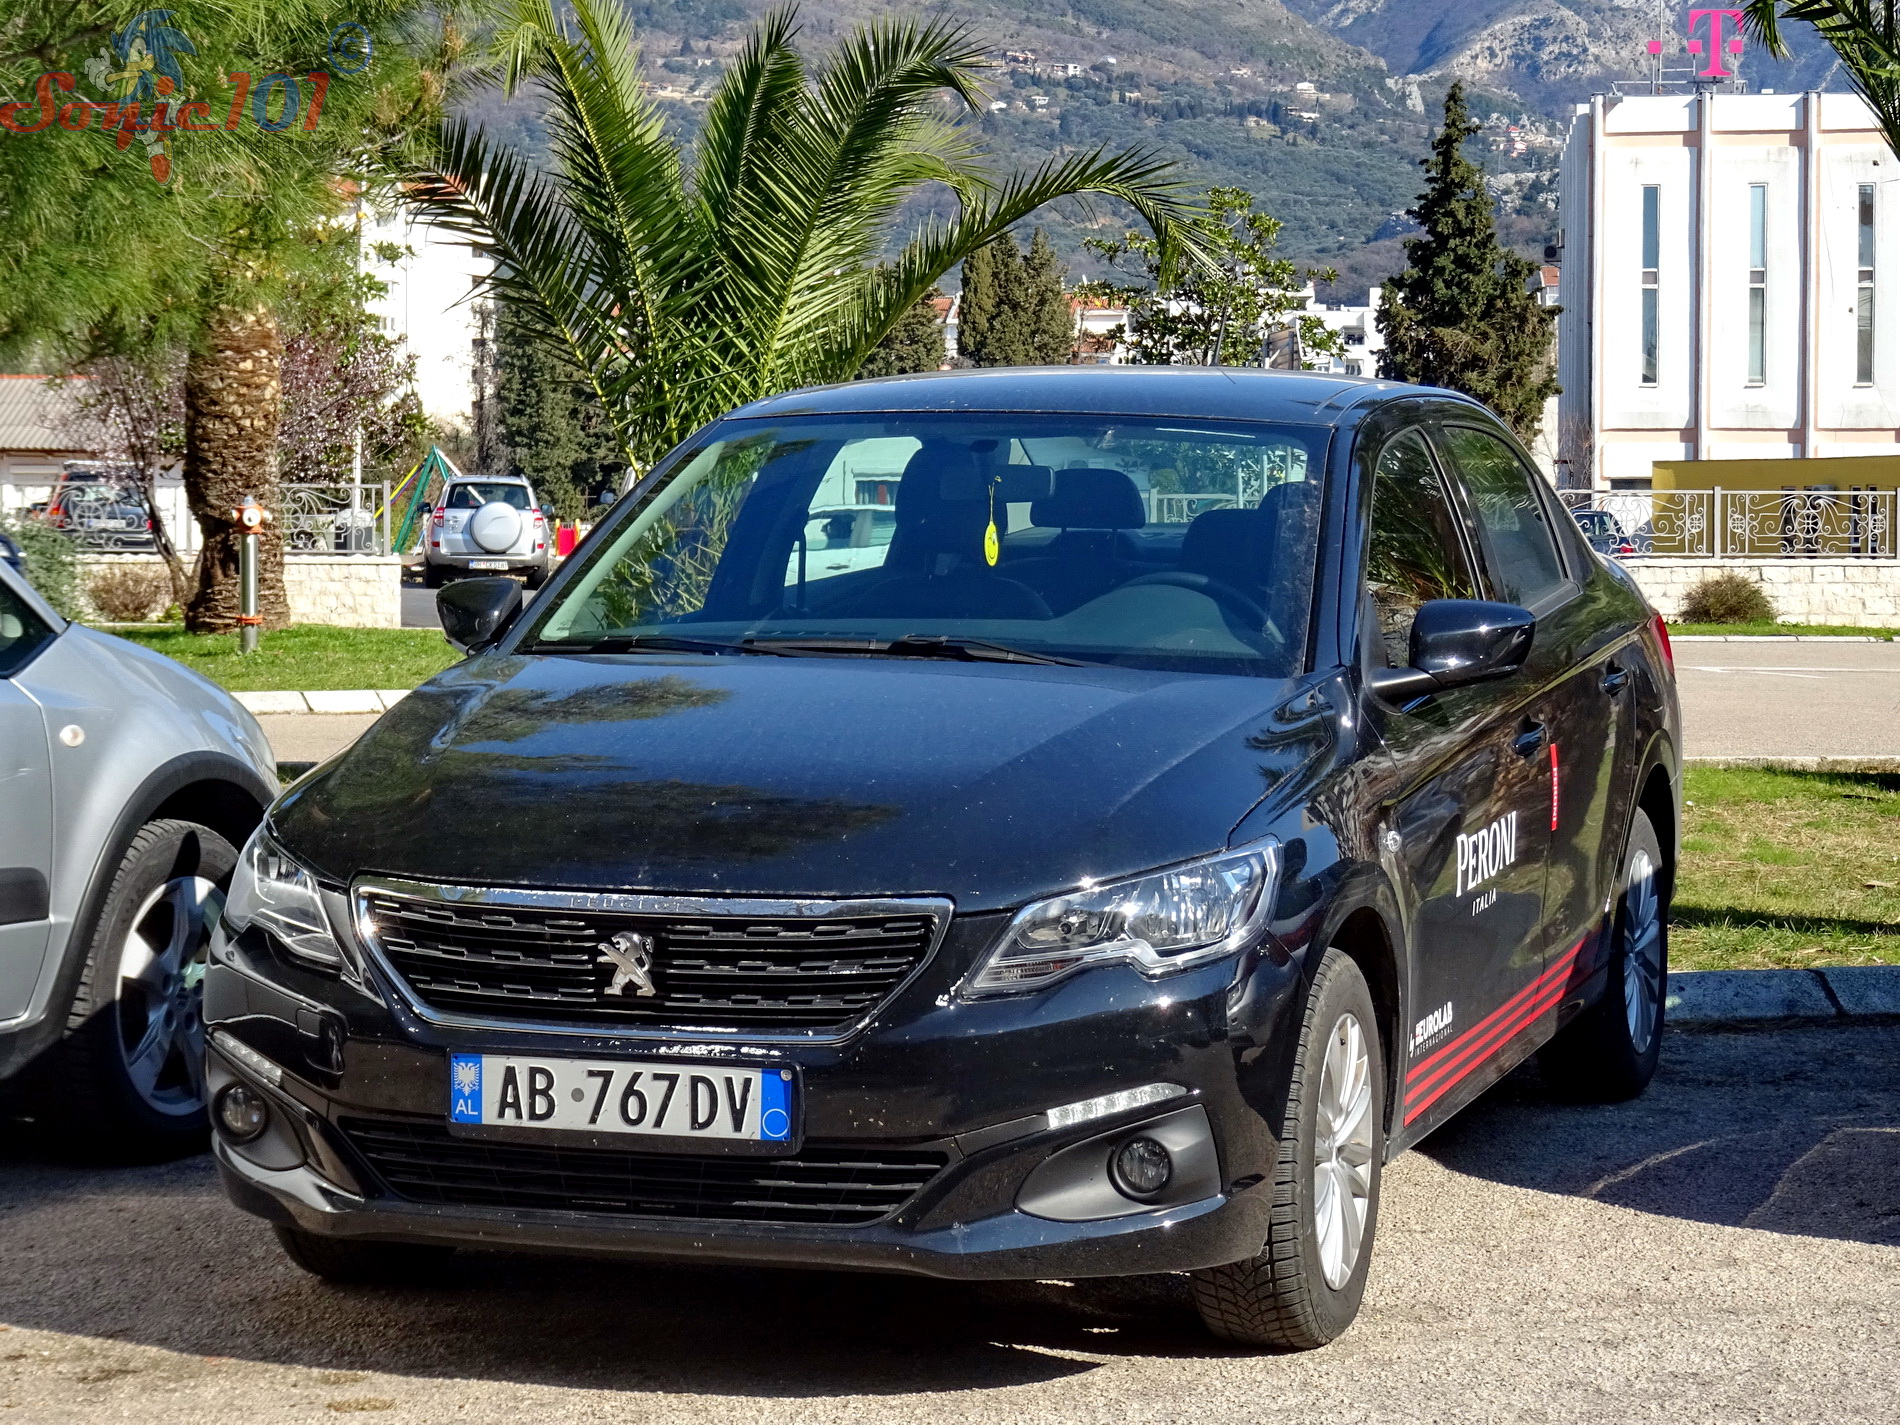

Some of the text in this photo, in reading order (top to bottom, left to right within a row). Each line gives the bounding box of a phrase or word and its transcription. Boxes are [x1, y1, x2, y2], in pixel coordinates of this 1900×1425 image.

[1688, 9, 1743, 76] T
[1456, 811, 1516, 898] PERONI
[1472, 888, 1497, 917] ITALIA
[1416, 1001, 1453, 1047] EUROLAB
[454, 1098, 479, 1116] AL
[496, 1064, 753, 1133] AB 767 DV
